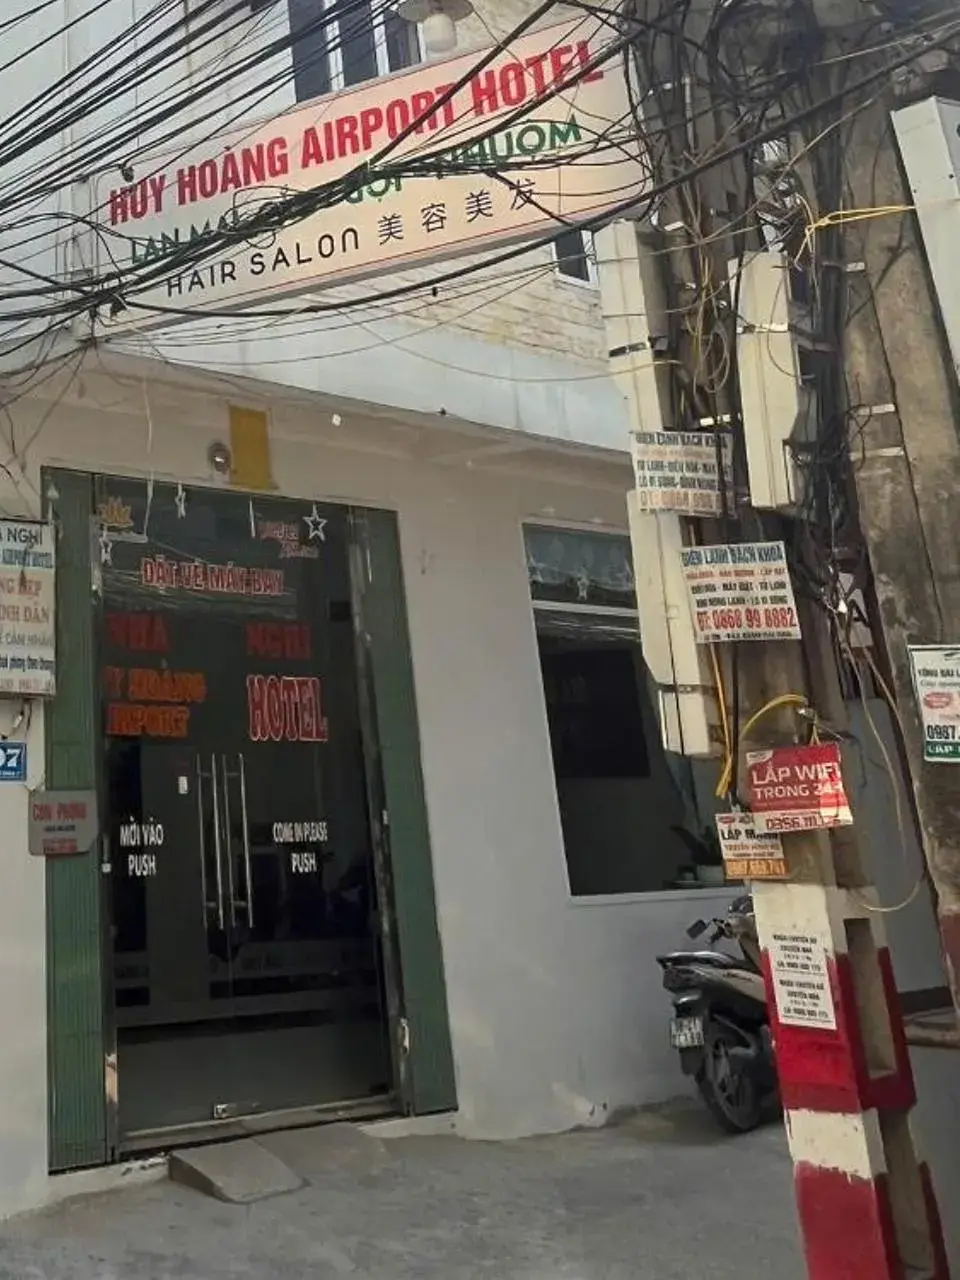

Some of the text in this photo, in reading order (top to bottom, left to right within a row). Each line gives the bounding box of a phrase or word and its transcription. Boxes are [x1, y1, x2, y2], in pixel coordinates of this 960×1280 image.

[109, 40, 604, 226] HUY HOÀNG AIRPORT HOTEL
[167, 261, 236, 297] HAIR
[246, 674, 328, 742] HOTEL
[794, 762, 842, 781] WIFI
[752, 783, 810, 800] TRONG
[142, 817, 164, 847] VÀO
[128, 855, 157, 877] PUSH
[291, 853, 317, 874] PUSH
